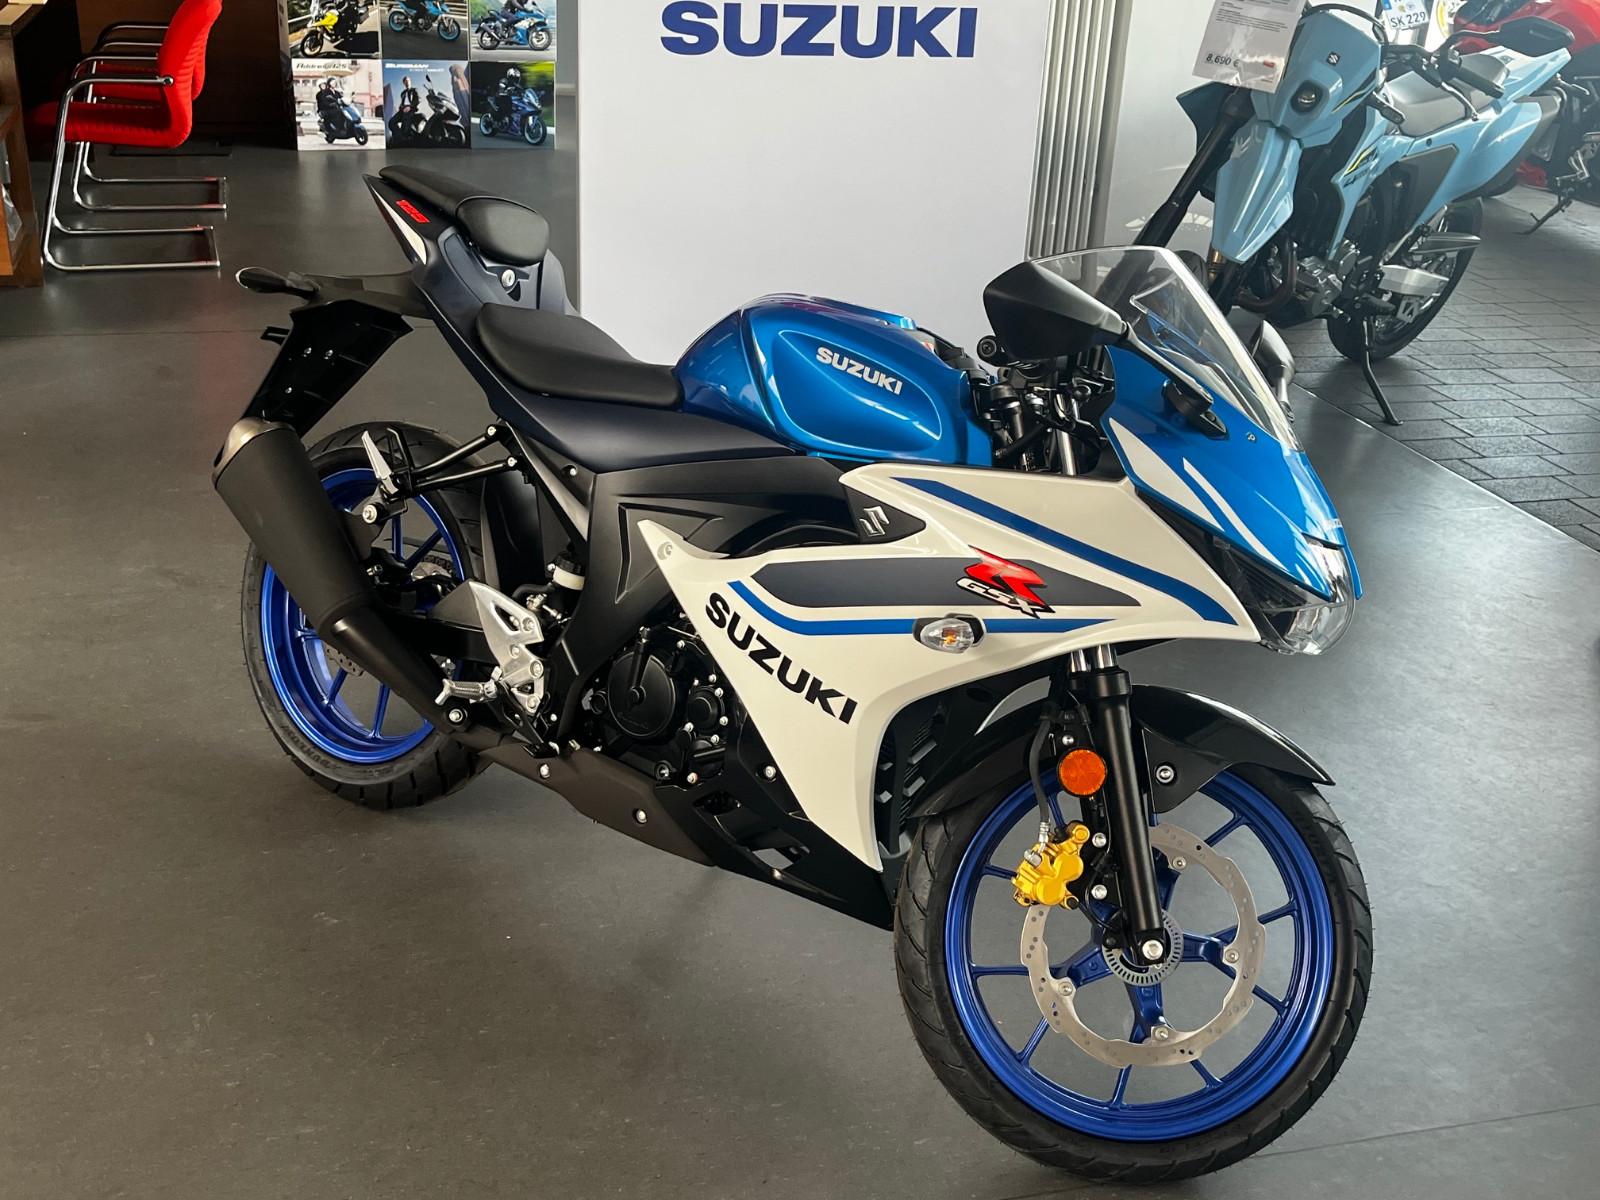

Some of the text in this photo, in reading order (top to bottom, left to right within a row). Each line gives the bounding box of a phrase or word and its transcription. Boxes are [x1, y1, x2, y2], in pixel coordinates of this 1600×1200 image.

[660, 0, 978, 58] SUZUKI
[1390, 16, 1405, 28] SK
[1206, 53, 1231, 66] 8.690
[816, 346, 903, 395] SUZUKI
[705, 592, 858, 725] SUZUKI
